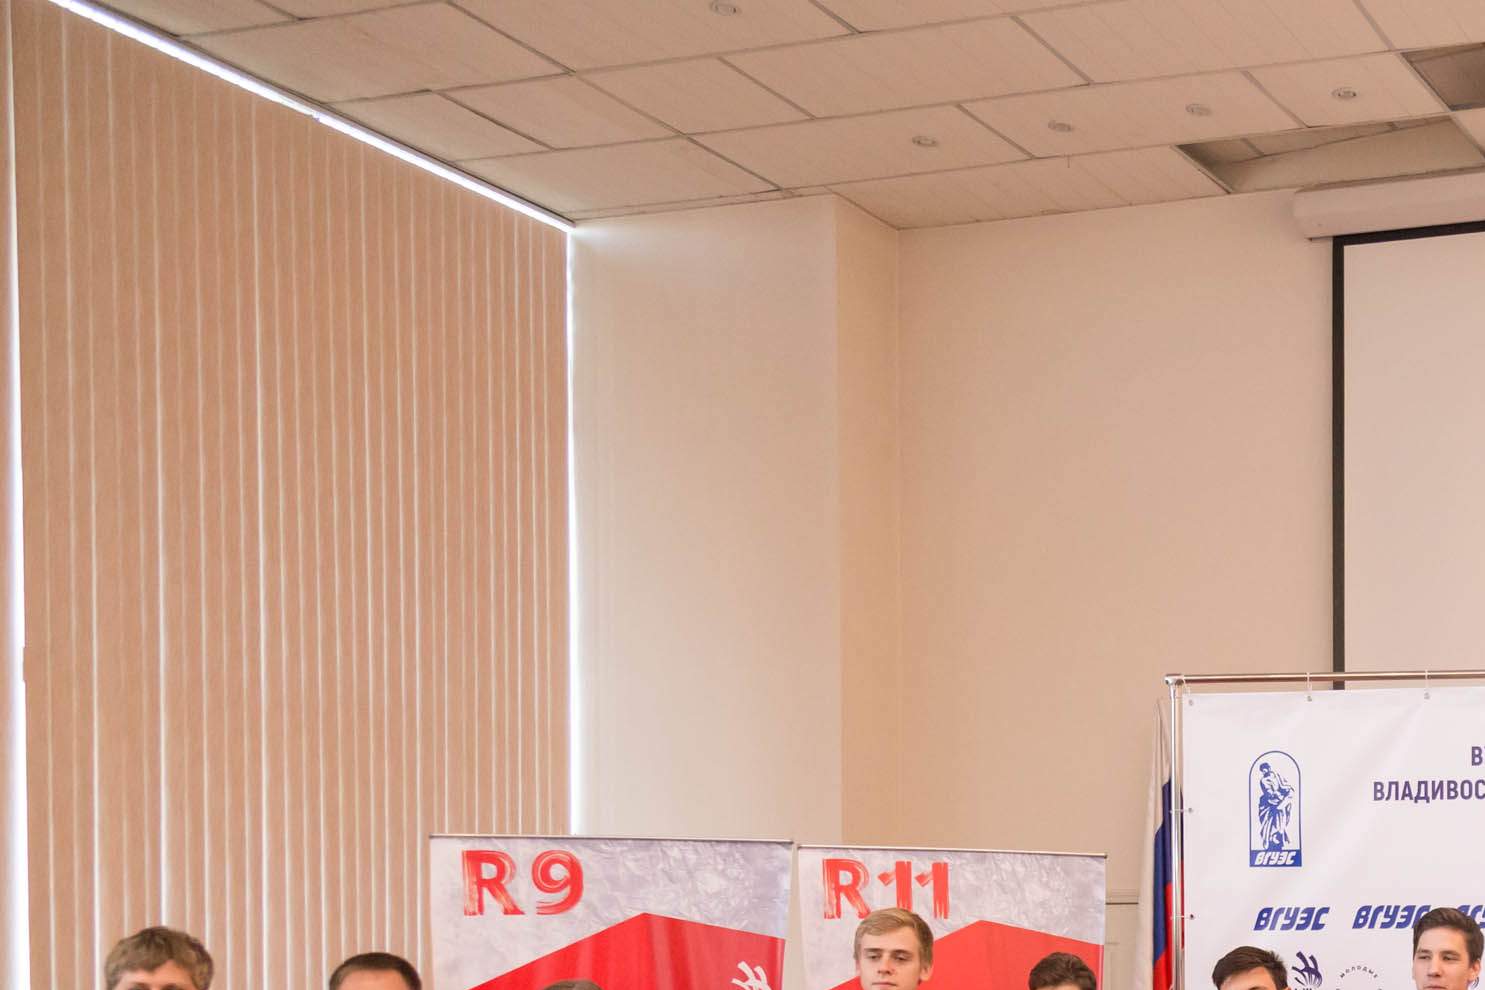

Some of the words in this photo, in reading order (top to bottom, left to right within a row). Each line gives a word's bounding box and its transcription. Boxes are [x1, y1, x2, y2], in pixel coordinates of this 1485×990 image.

[1254, 850, 1297, 865] ВГУЭС
[461, 849, 585, 916] R9
[1253, 907, 1330, 931] ВГУЭС
